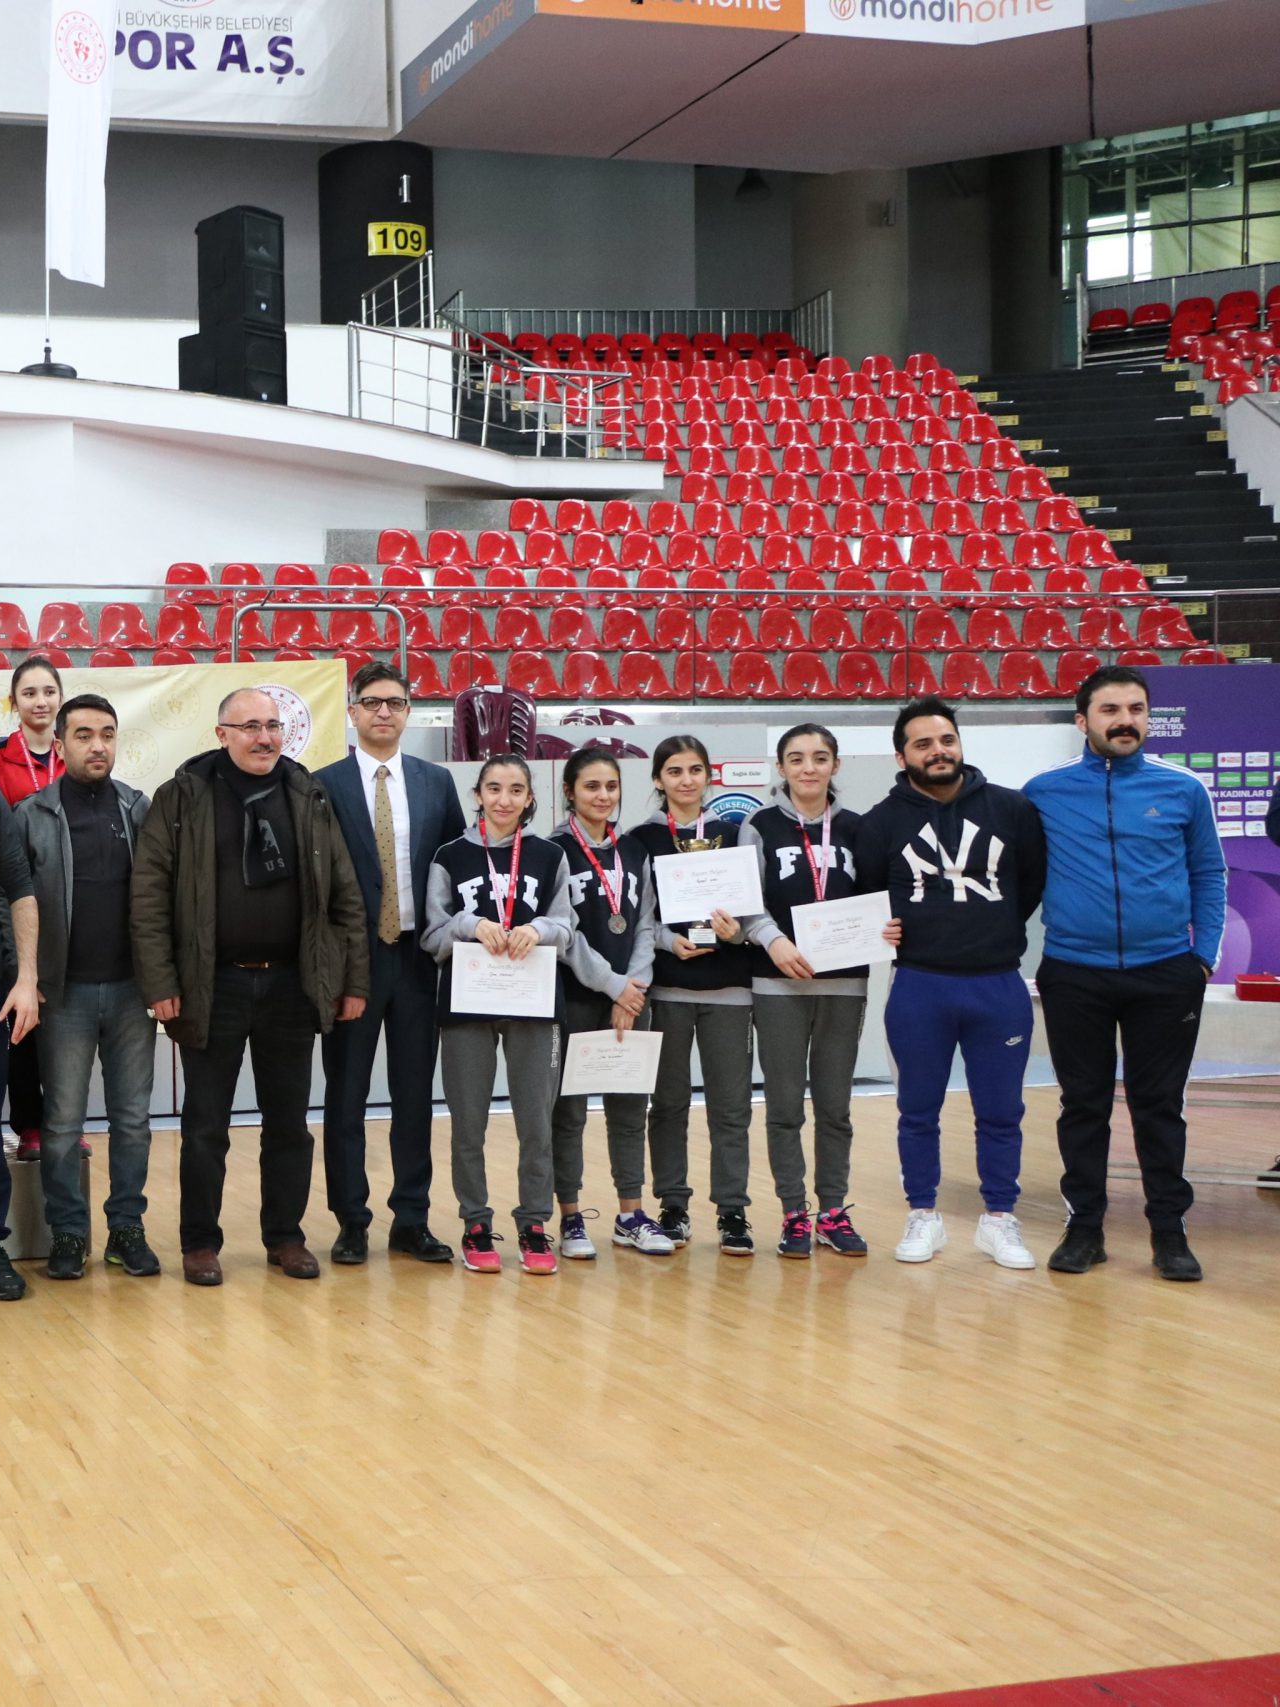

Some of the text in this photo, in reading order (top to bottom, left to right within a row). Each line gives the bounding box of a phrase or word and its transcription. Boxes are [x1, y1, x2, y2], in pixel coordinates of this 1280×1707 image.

[125, 11, 212, 30] BÜYÜKŞEHİR
[216, 16, 293, 32] BELEDİYESİ
[217, 34, 305, 84] A.Ş.
[377, 228, 422, 252] 109
[1147, 723, 1186, 731] ASKETBOL
[901, 818, 1005, 902] NY
